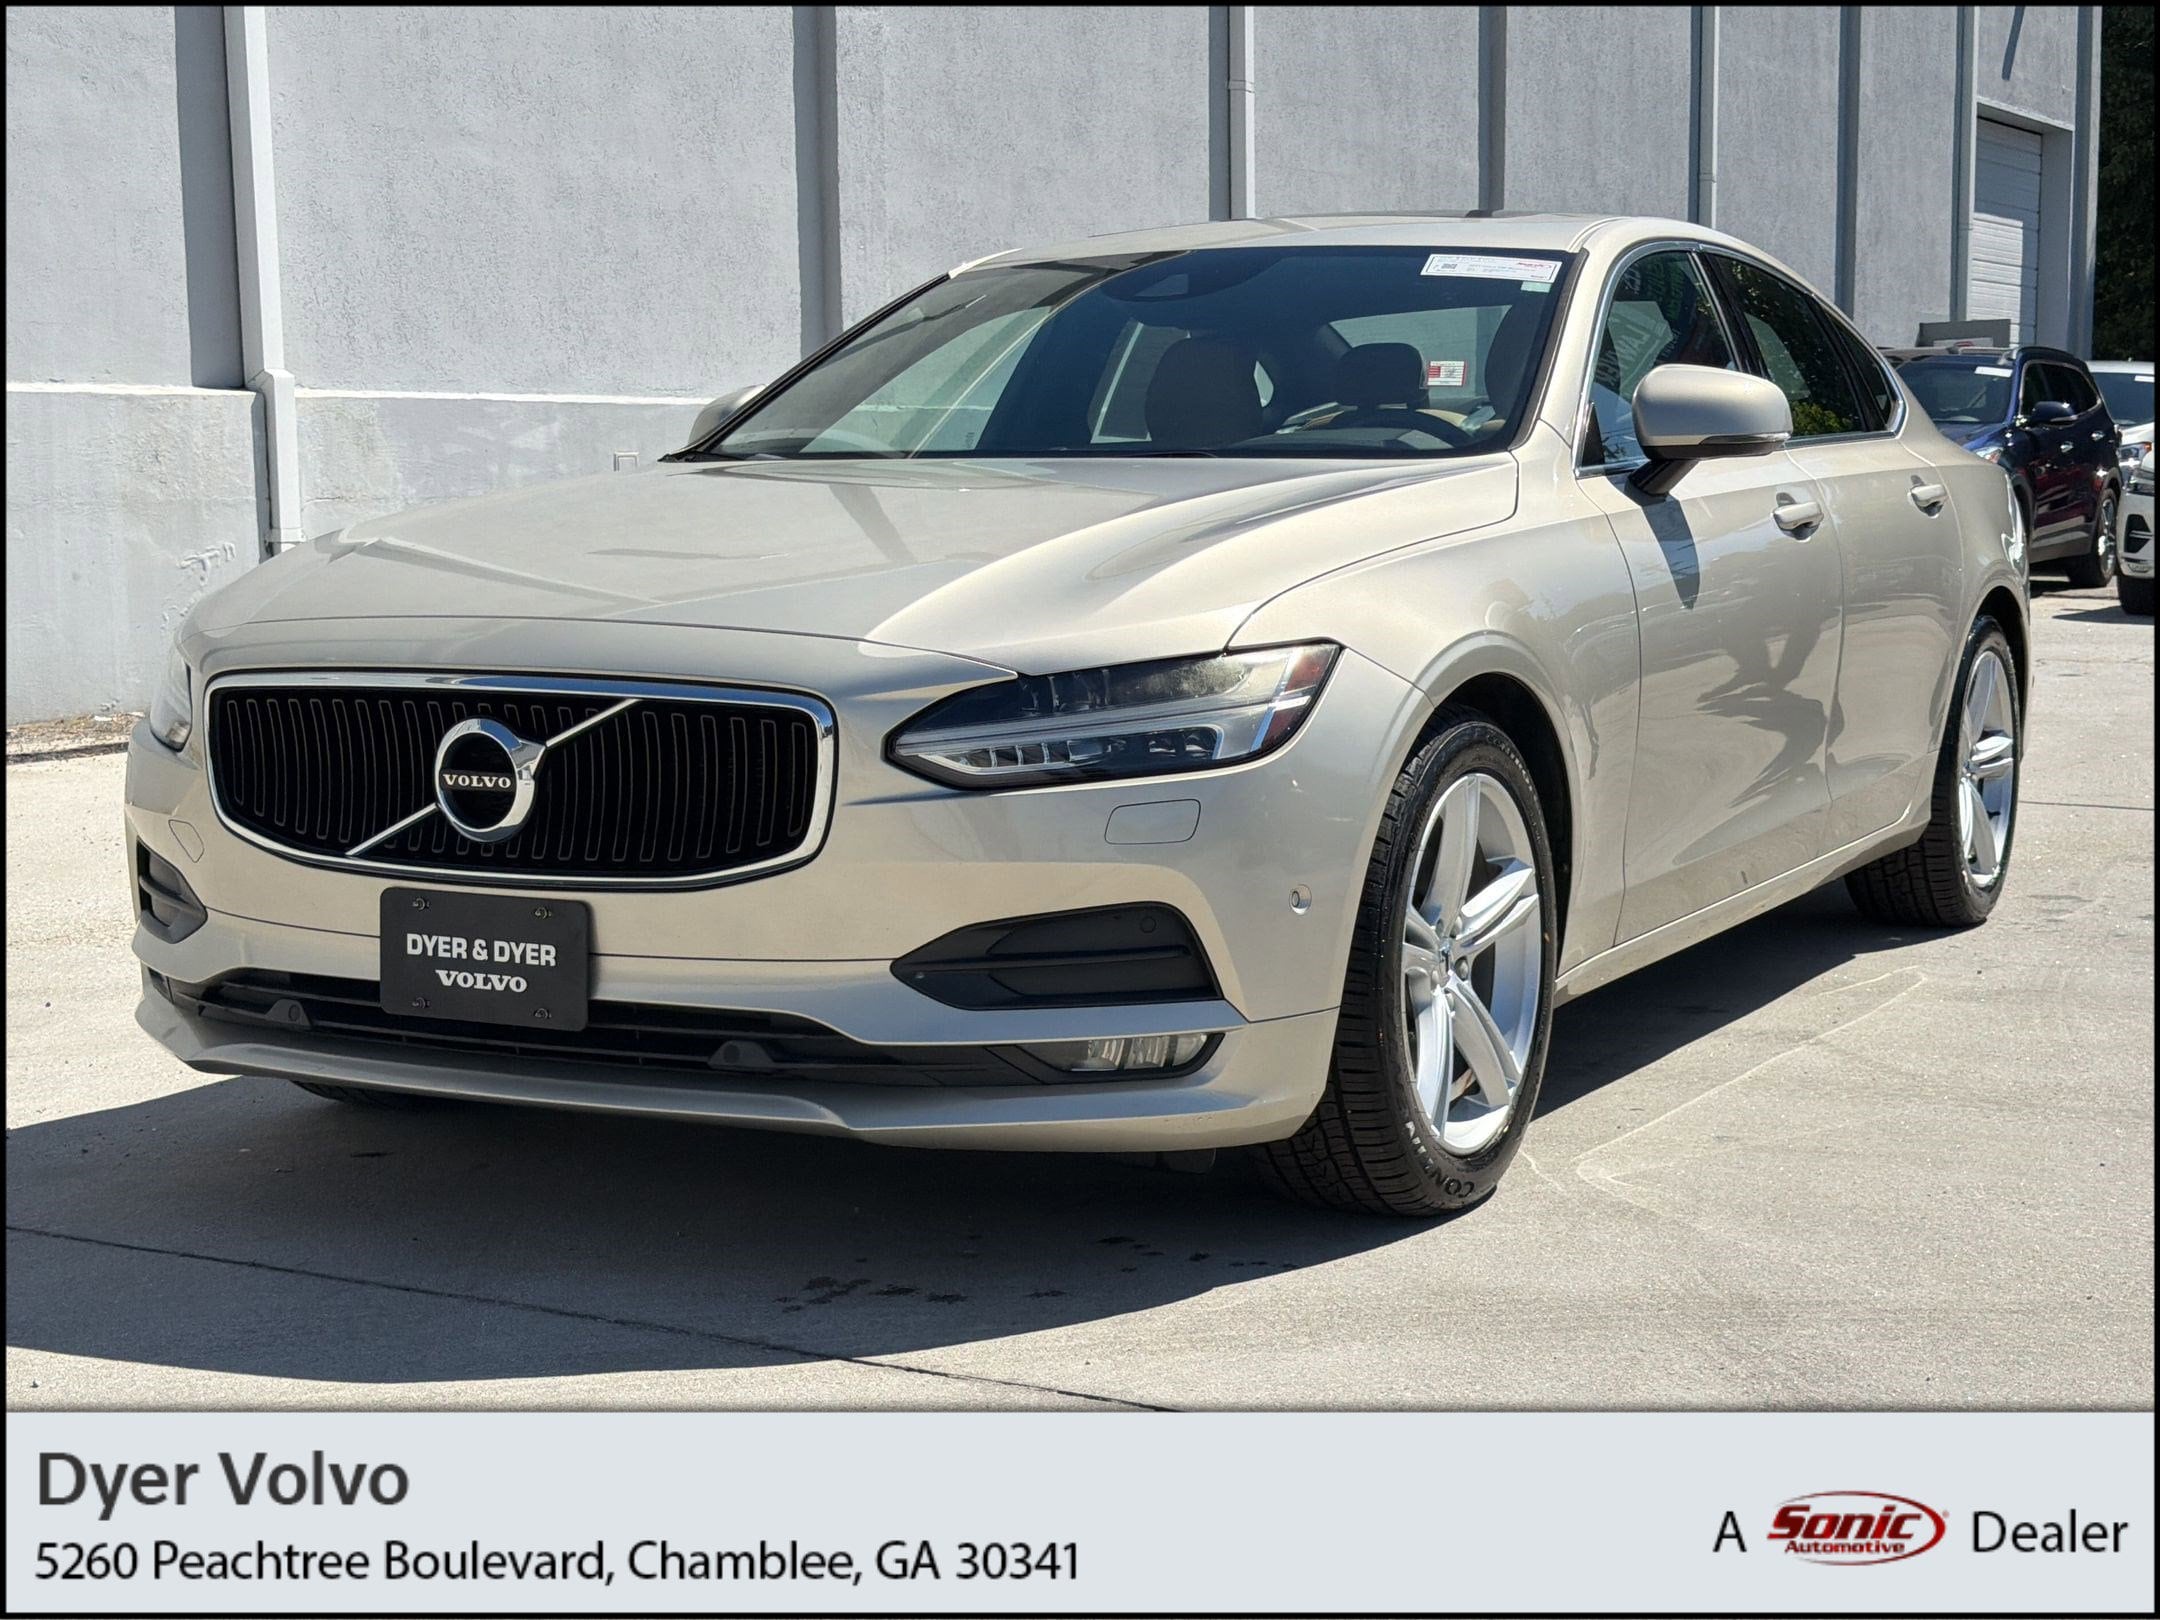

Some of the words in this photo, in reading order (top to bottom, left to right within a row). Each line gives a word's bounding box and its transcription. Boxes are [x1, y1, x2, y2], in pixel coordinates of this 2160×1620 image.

[442, 773, 512, 789] VOLVO
[406, 933, 468, 960] DYER
[471, 938, 489, 961] &
[493, 940, 556, 967] DYER
[435, 969, 528, 993] VOLVO
